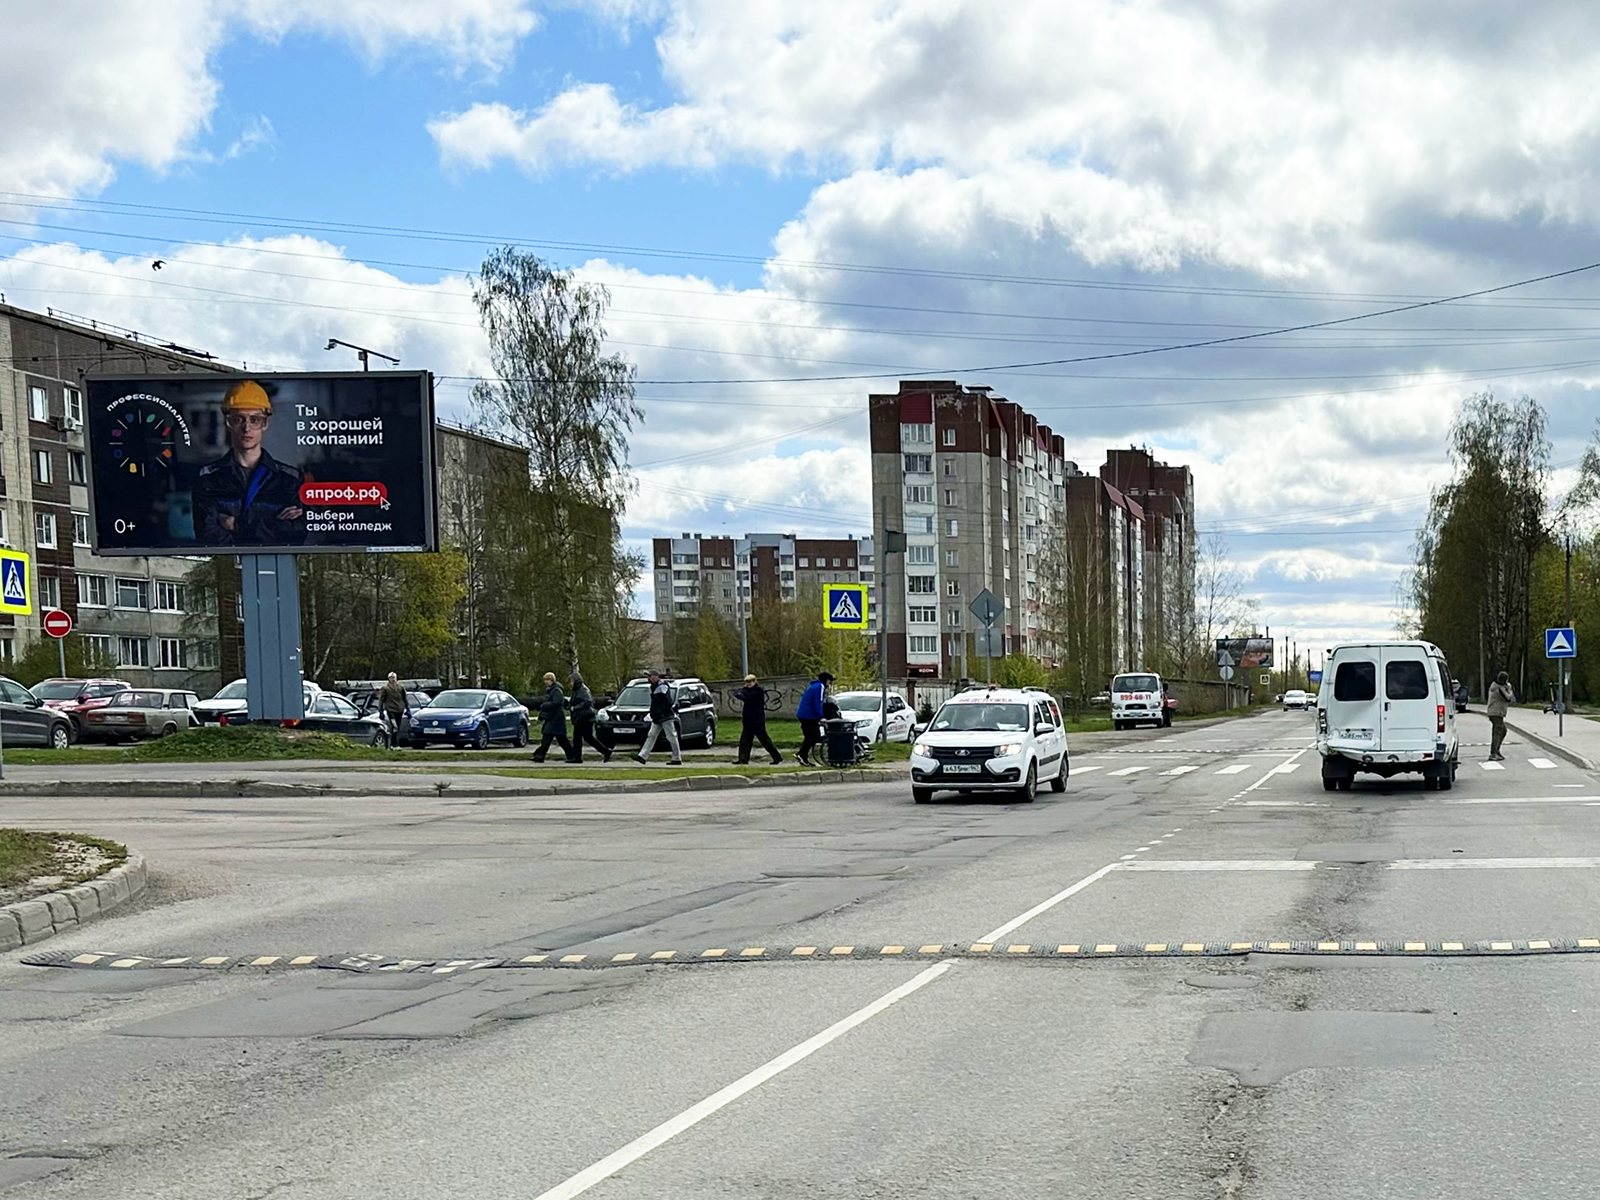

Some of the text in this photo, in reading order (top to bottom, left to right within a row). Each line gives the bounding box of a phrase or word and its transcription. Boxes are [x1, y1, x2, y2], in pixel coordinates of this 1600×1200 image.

[295, 404, 318, 417] Ты
[106, 393, 191, 447] ПРОФЕССИОНАЛИТЕТ
[296, 417, 383, 433] в хорошей
[297, 432, 384, 445] компании!
[305, 486, 381, 501] япроф.рф
[306, 510, 355, 521] Выбери
[114, 518, 136, 534] 0+
[306, 521, 393, 532] свой колледж
